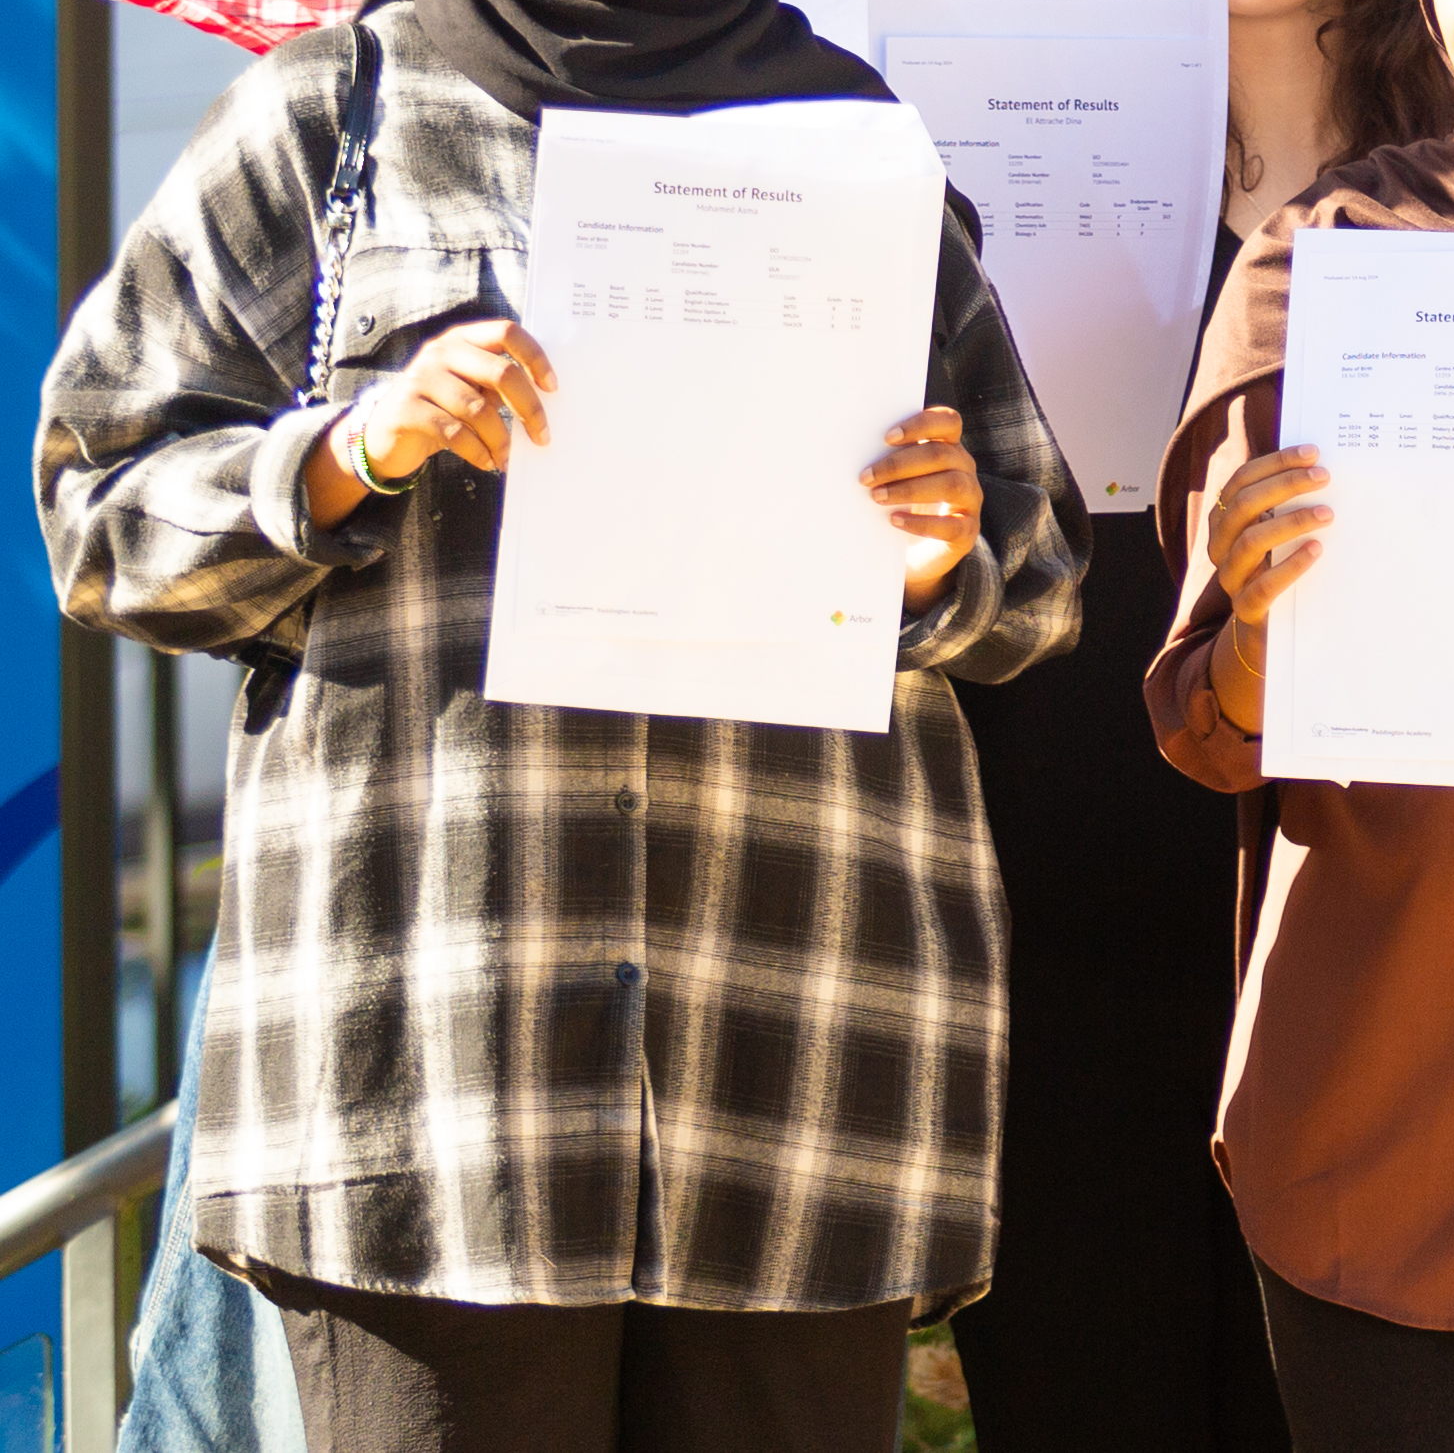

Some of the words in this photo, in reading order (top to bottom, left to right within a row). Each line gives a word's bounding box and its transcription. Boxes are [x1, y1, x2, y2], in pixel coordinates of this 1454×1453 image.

[988, 98, 1054, 111] Statement
[1057, 99, 1071, 111] of
[1074, 99, 1120, 112] Results
[958, 140, 1000, 148] Information
[654, 181, 728, 199] Statement
[732, 188, 748, 199] of
[751, 188, 802, 203] Results
[696, 204, 735, 213] Mohamed
[577, 220, 617, 231] Candidate
[618, 223, 664, 234] Information
[1342, 352, 1380, 360] Candidate
[1120, 484, 1141, 493] Arbor
[848, 614, 874, 624] Arbor
[1371, 728, 1404, 737] Paddington
[1406, 729, 1432, 738] Academy
